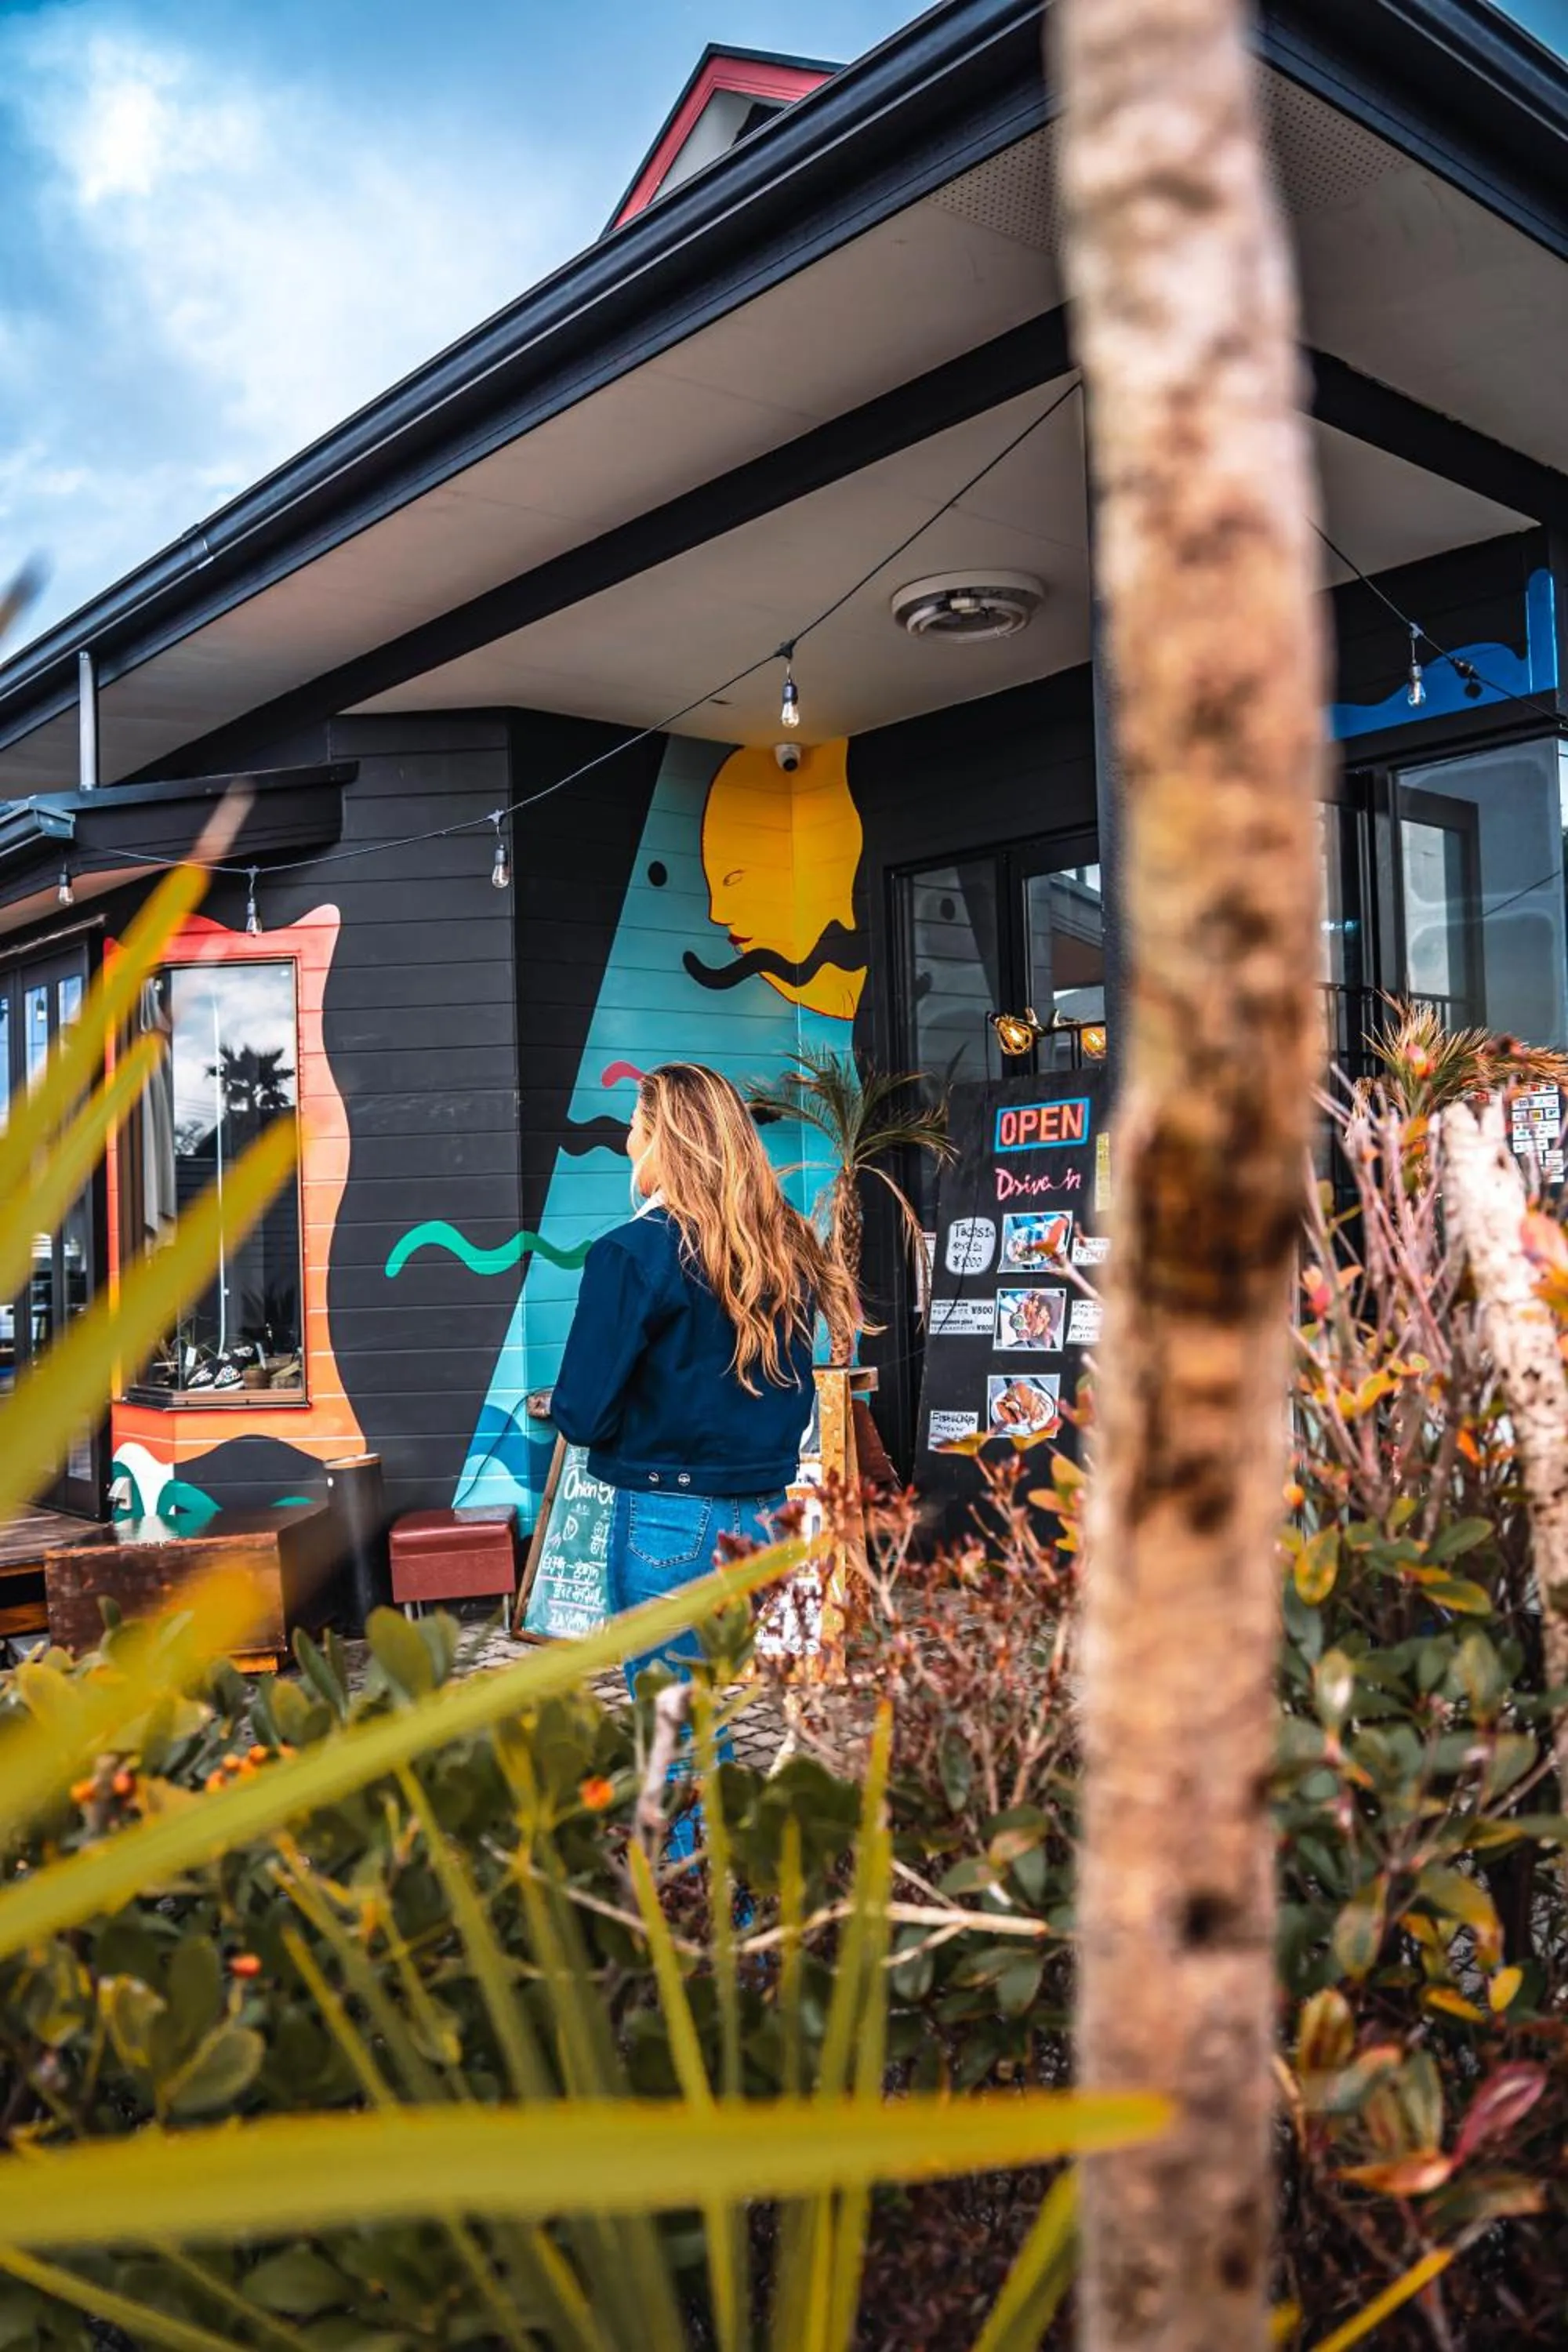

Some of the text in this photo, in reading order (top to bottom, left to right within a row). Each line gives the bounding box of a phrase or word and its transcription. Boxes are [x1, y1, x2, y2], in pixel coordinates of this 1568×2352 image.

[1000, 1102, 1084, 1146] OPEN
[995, 1167, 1081, 1201] Drive in
[564, 1469, 597, 1501] Onion
